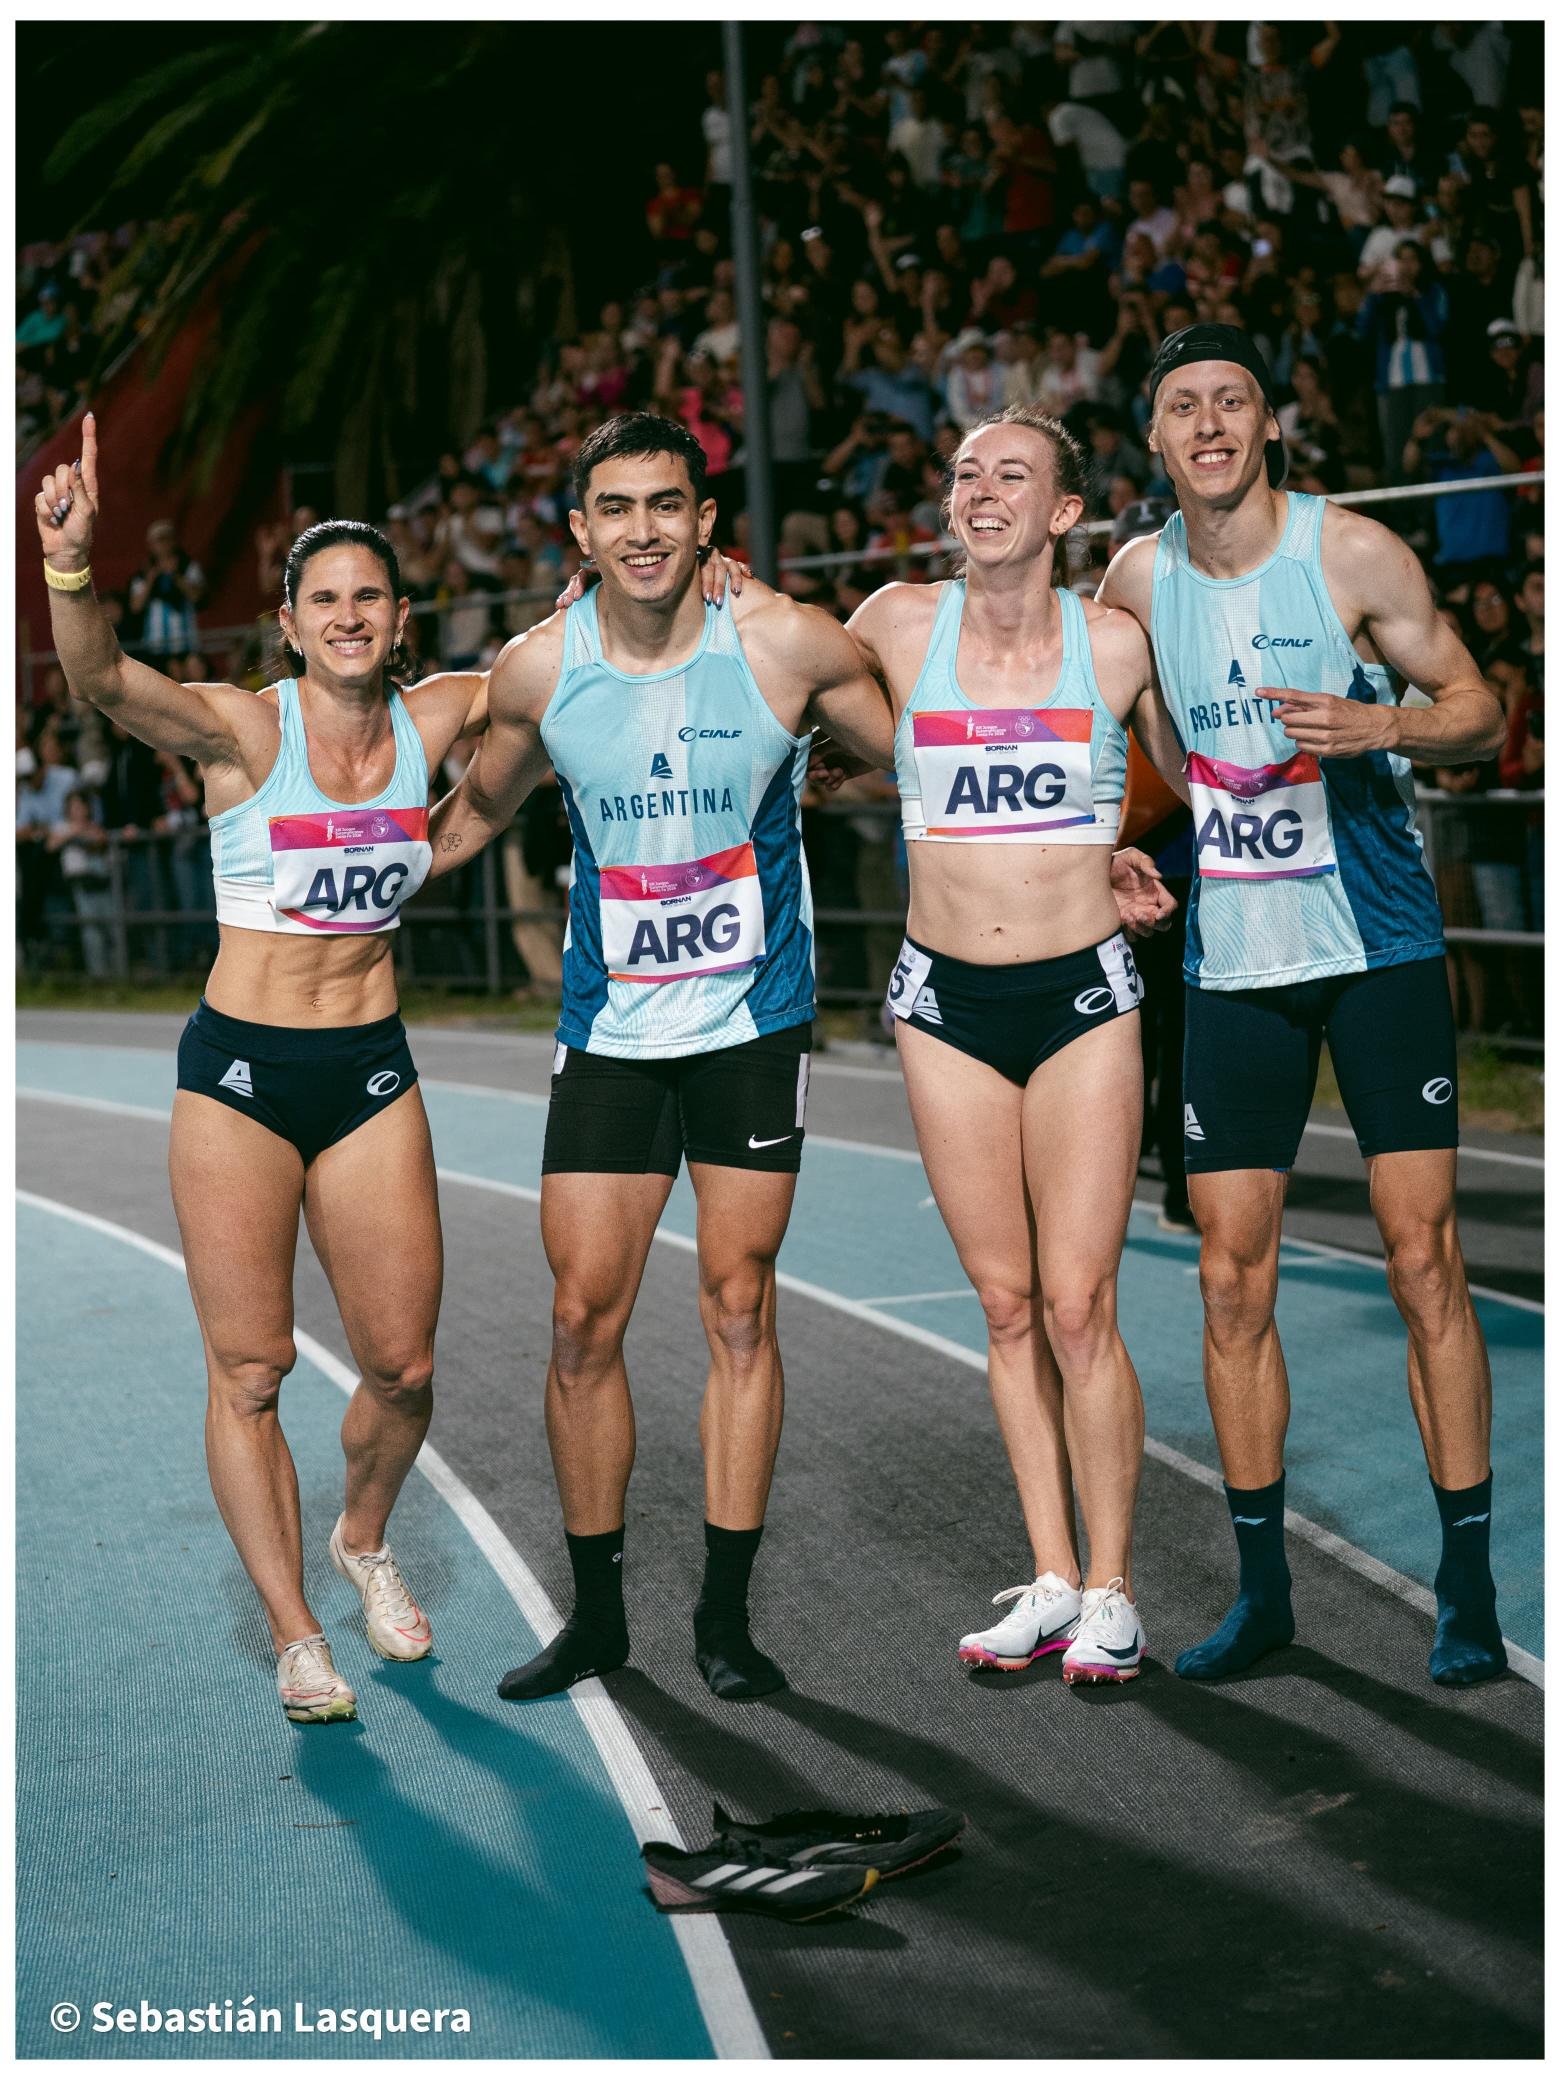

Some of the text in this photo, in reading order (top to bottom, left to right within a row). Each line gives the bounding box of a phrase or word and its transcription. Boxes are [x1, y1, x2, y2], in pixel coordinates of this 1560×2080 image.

[1271, 638, 1313, 648] CIALF
[1189, 698, 1285, 733] ARGENTI
[698, 729, 742, 739] CIALF
[984, 744, 1018, 752] BORNAN
[599, 787, 733, 822] ARGENTINA
[944, 763, 1067, 815] ARG
[344, 845, 374, 854] BORNAN
[1197, 808, 1303, 859] ARG
[303, 862, 409, 912] ARG
[660, 895, 692, 906] BORNAN
[627, 903, 741, 965] ARG
[889, 960, 912, 1000] 5
